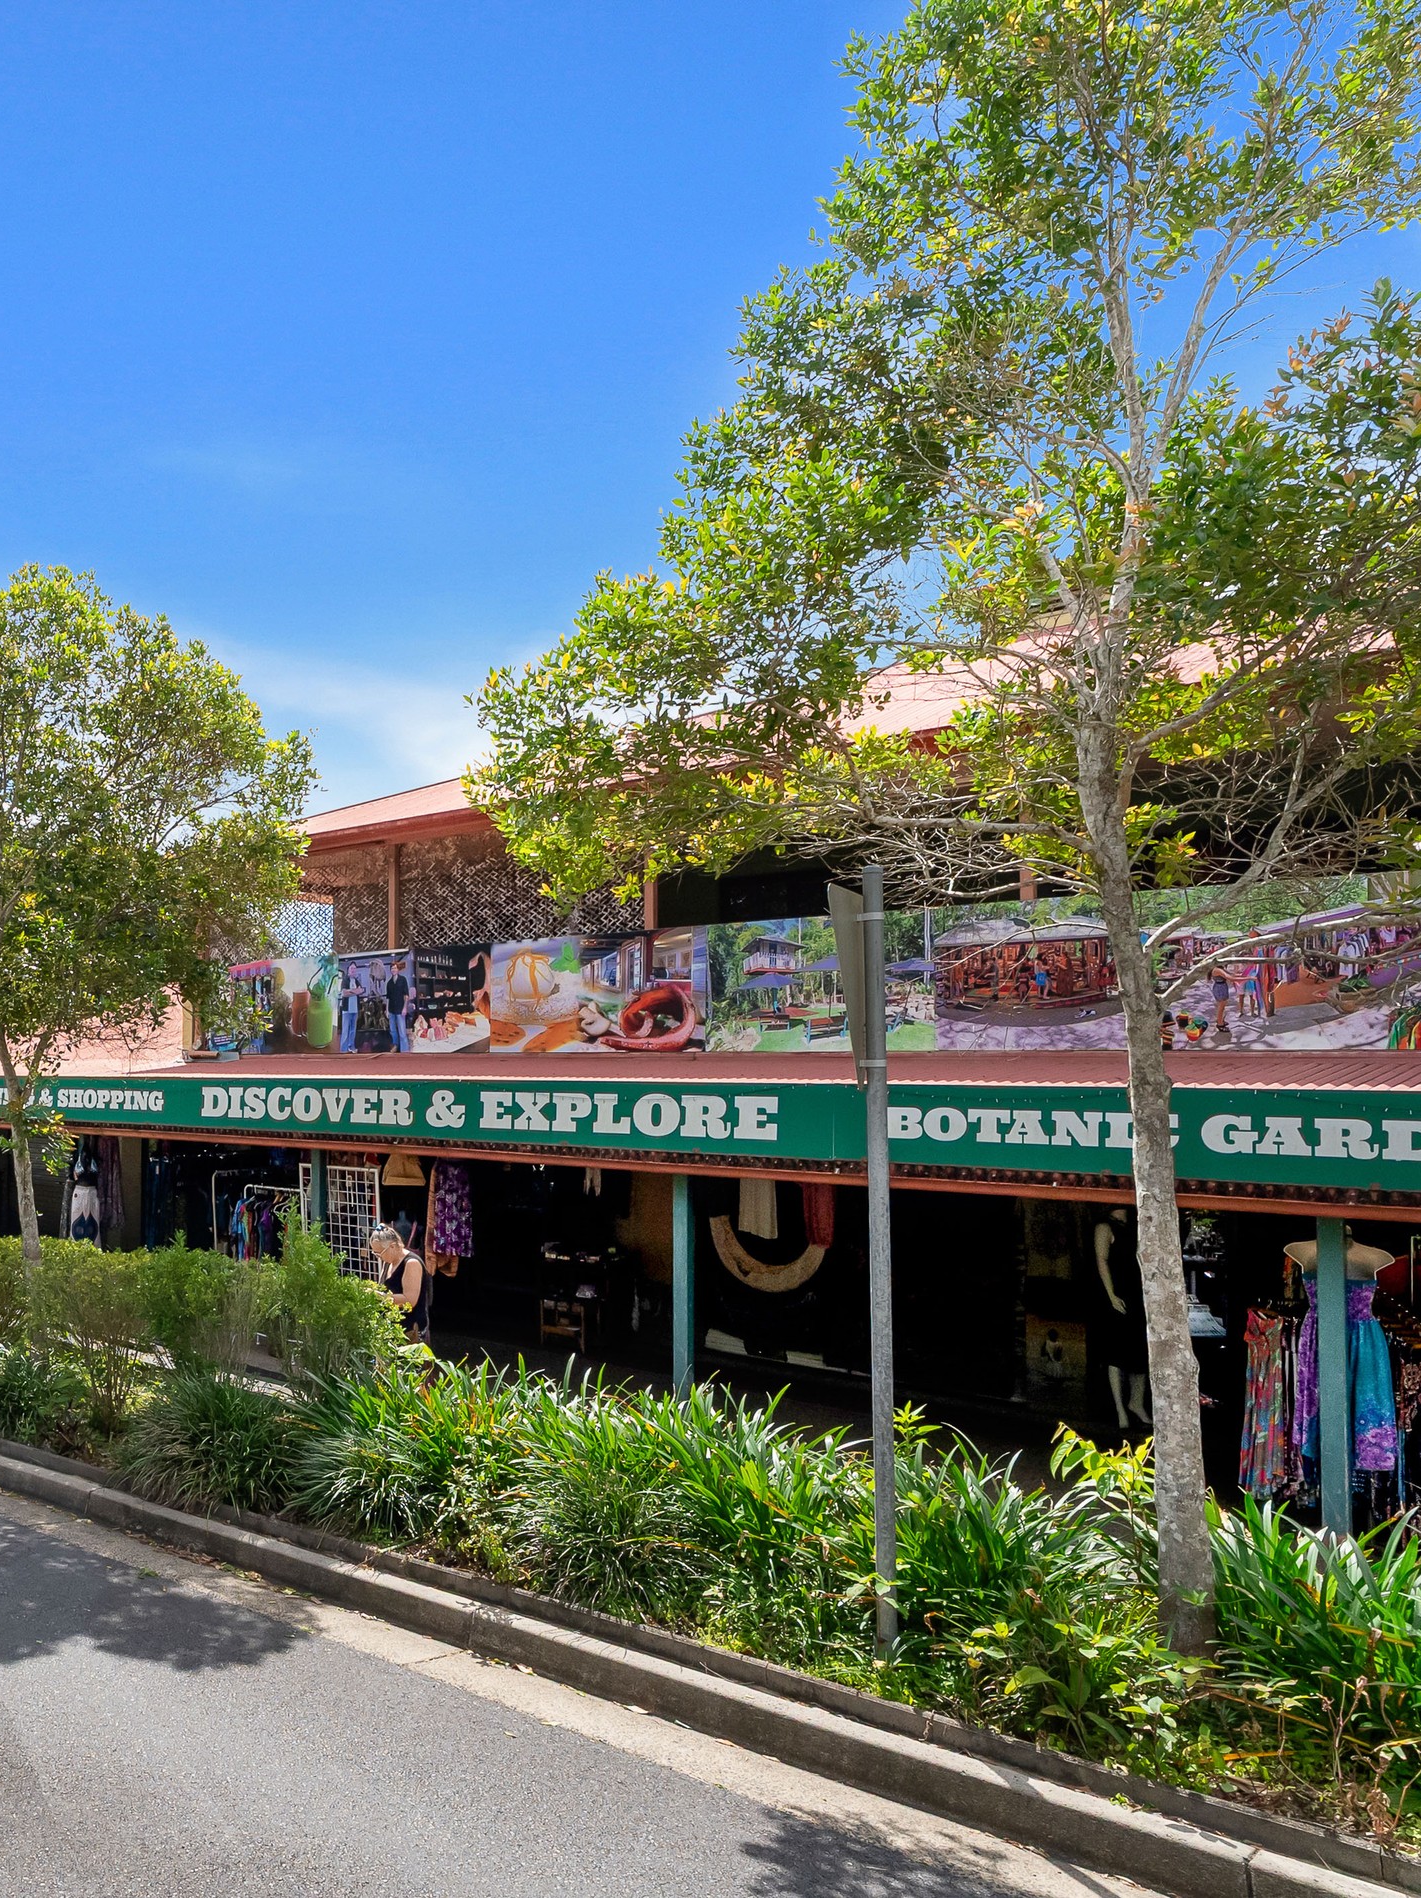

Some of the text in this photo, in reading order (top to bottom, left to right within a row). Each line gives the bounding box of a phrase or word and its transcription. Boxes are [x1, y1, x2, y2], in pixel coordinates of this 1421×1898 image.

[38, 1087, 54, 1108] &
[57, 1088, 165, 1112] SHOPPING
[200, 1086, 779, 1141] DISCOVER & EXPLORE
[886, 1106, 1180, 1149] BOTANI
